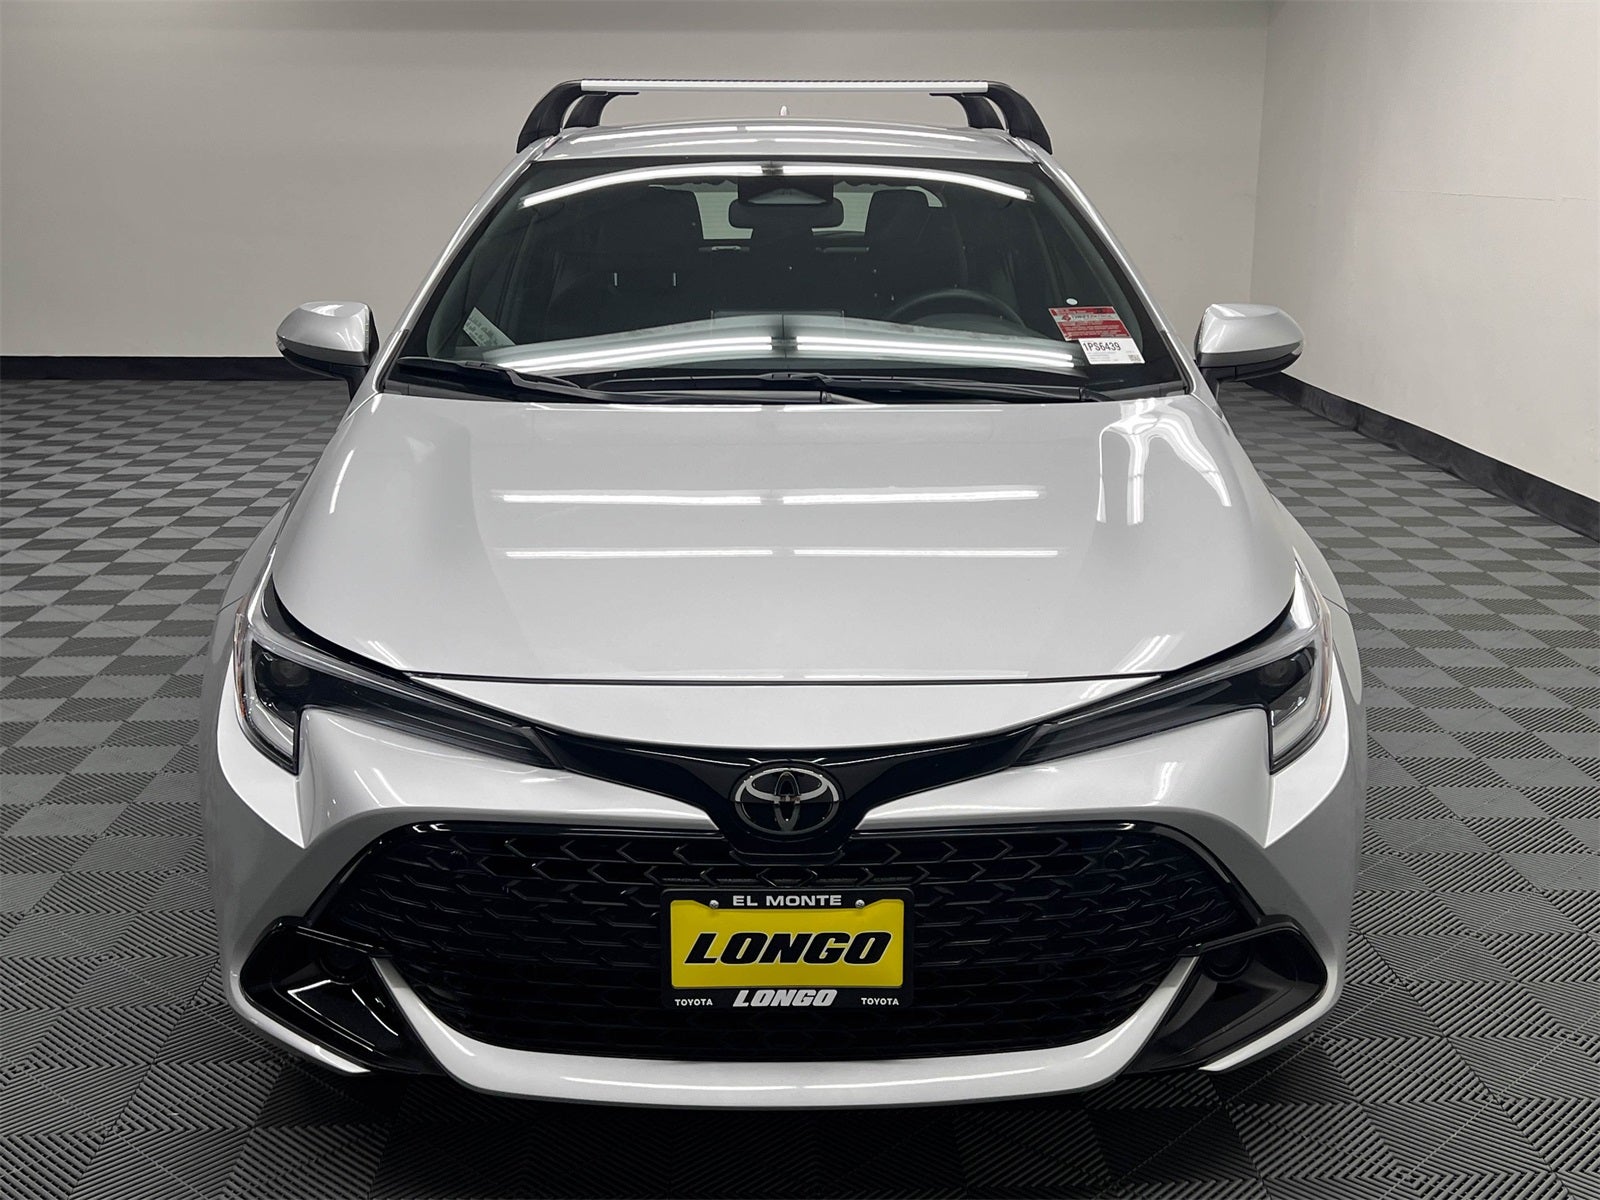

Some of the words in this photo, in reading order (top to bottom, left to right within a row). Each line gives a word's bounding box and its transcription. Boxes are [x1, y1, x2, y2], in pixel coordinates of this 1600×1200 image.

[1083, 342, 1121, 352] 1PS6439
[733, 895, 758, 907] EL
[765, 895, 842, 907] MONTE
[684, 931, 893, 965] LONGO
[674, 998, 713, 1007] TOYOTA
[733, 989, 838, 1007] LONGO
[861, 997, 900, 1006] TOYOTA
